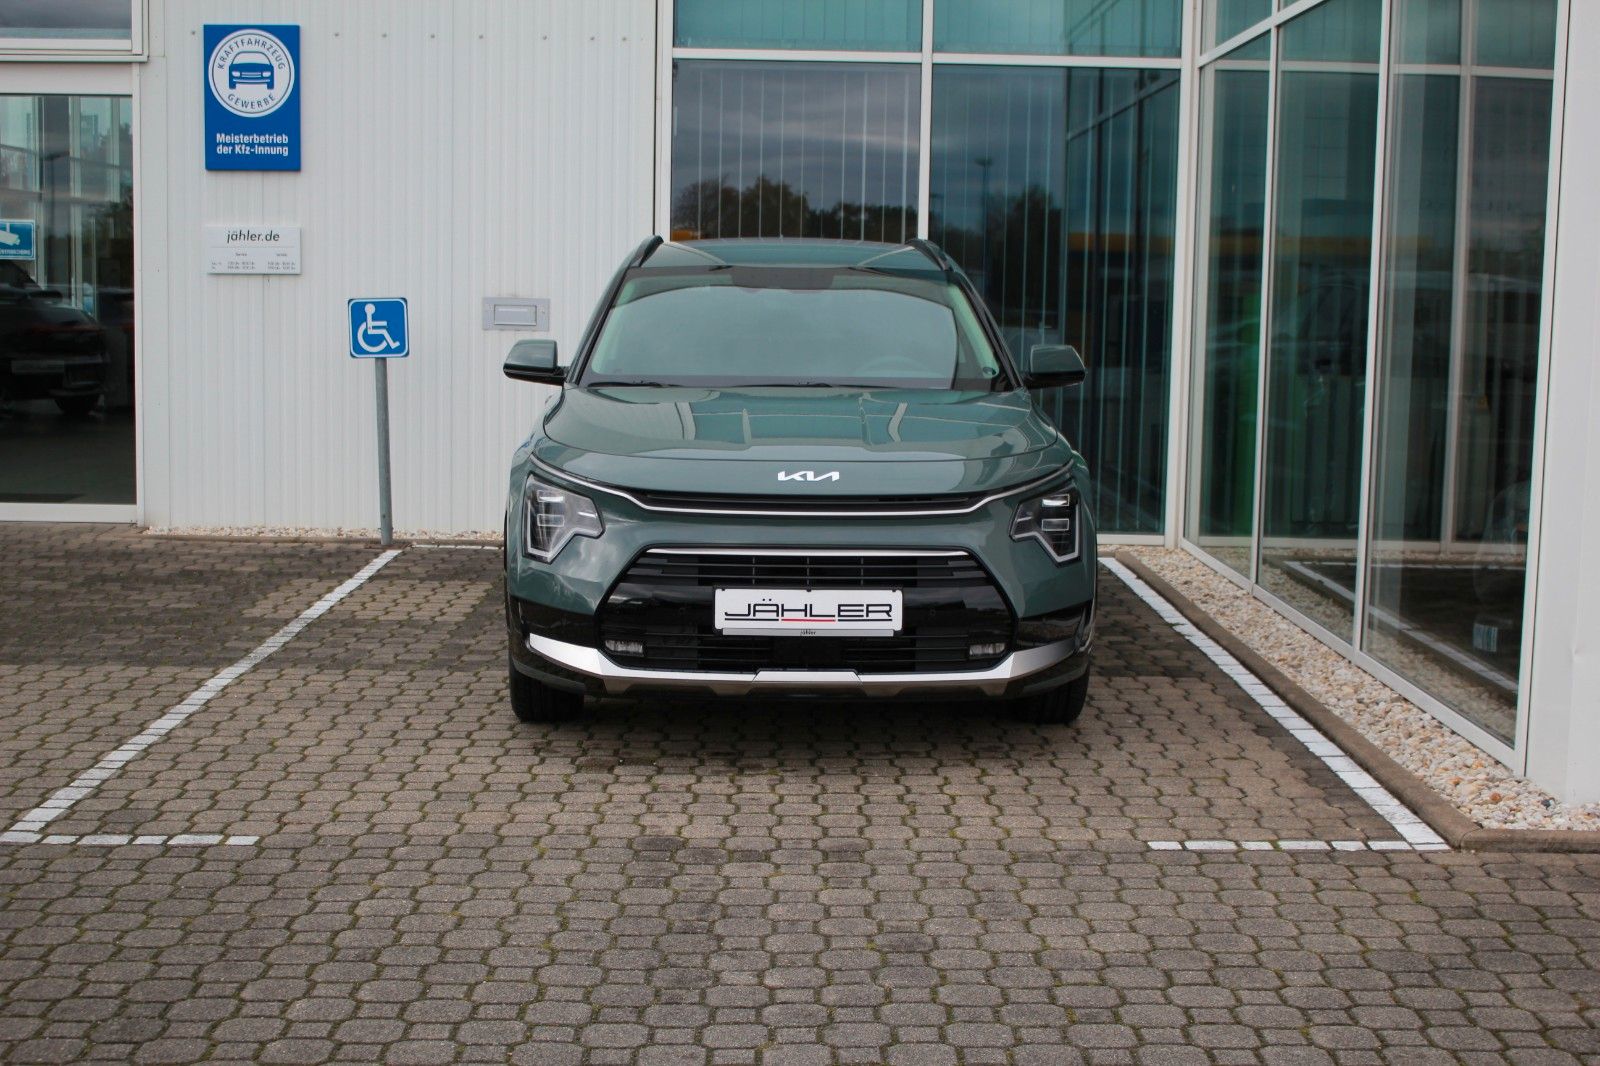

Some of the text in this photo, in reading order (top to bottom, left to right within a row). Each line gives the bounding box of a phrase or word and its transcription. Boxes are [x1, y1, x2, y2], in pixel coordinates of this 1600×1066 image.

[217, 37, 286, 70] KRAFTFAHRZEUG
[227, 92, 276, 110] GEWERBE
[216, 132, 289, 144] Meisterbetrieb
[216, 144, 289, 157] der Kfz-Innung
[226, 229, 280, 244] jähler.de
[724, 598, 893, 618] JÄHLER
